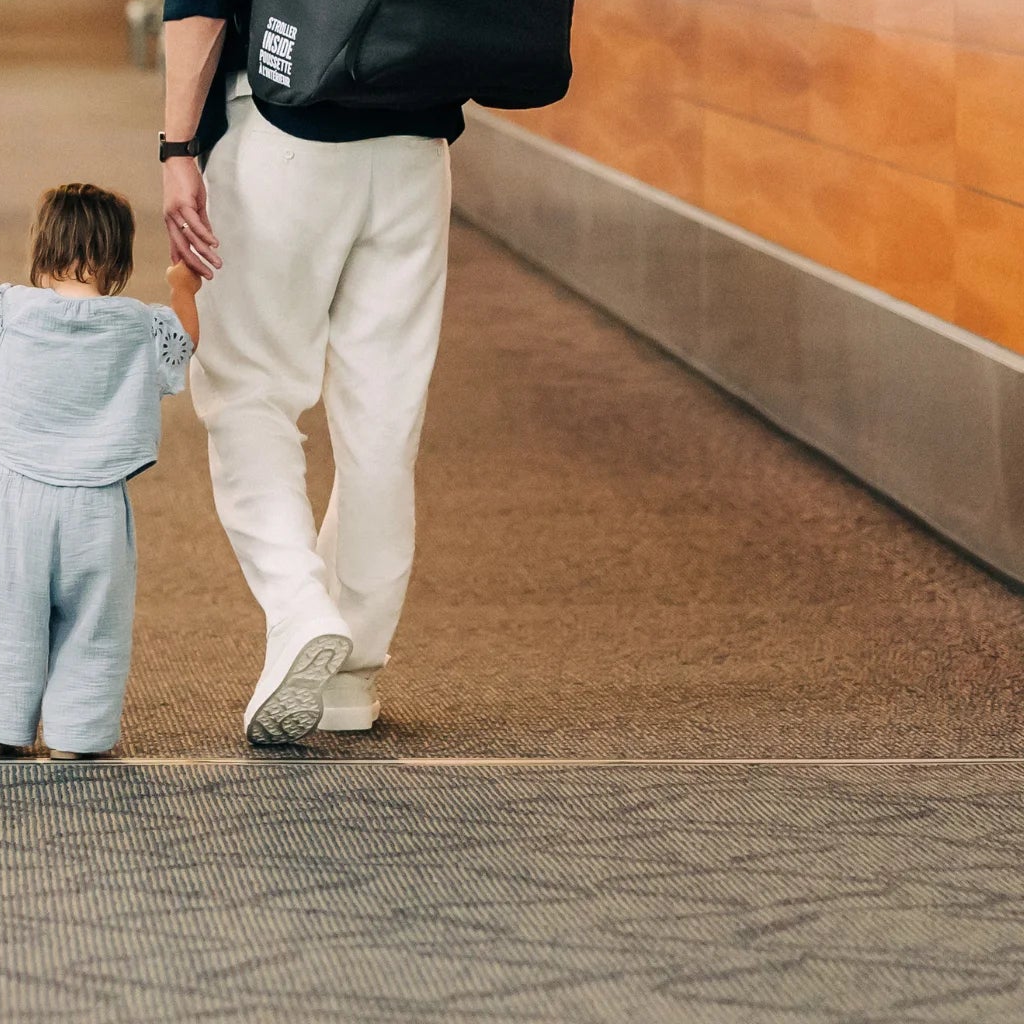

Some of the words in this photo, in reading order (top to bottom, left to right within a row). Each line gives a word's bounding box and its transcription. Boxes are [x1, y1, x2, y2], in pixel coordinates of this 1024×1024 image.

[267, 17, 297, 40] STROLLER
[262, 30, 295, 60] INSIDE
[259, 49, 293, 75] POUSSETTE
